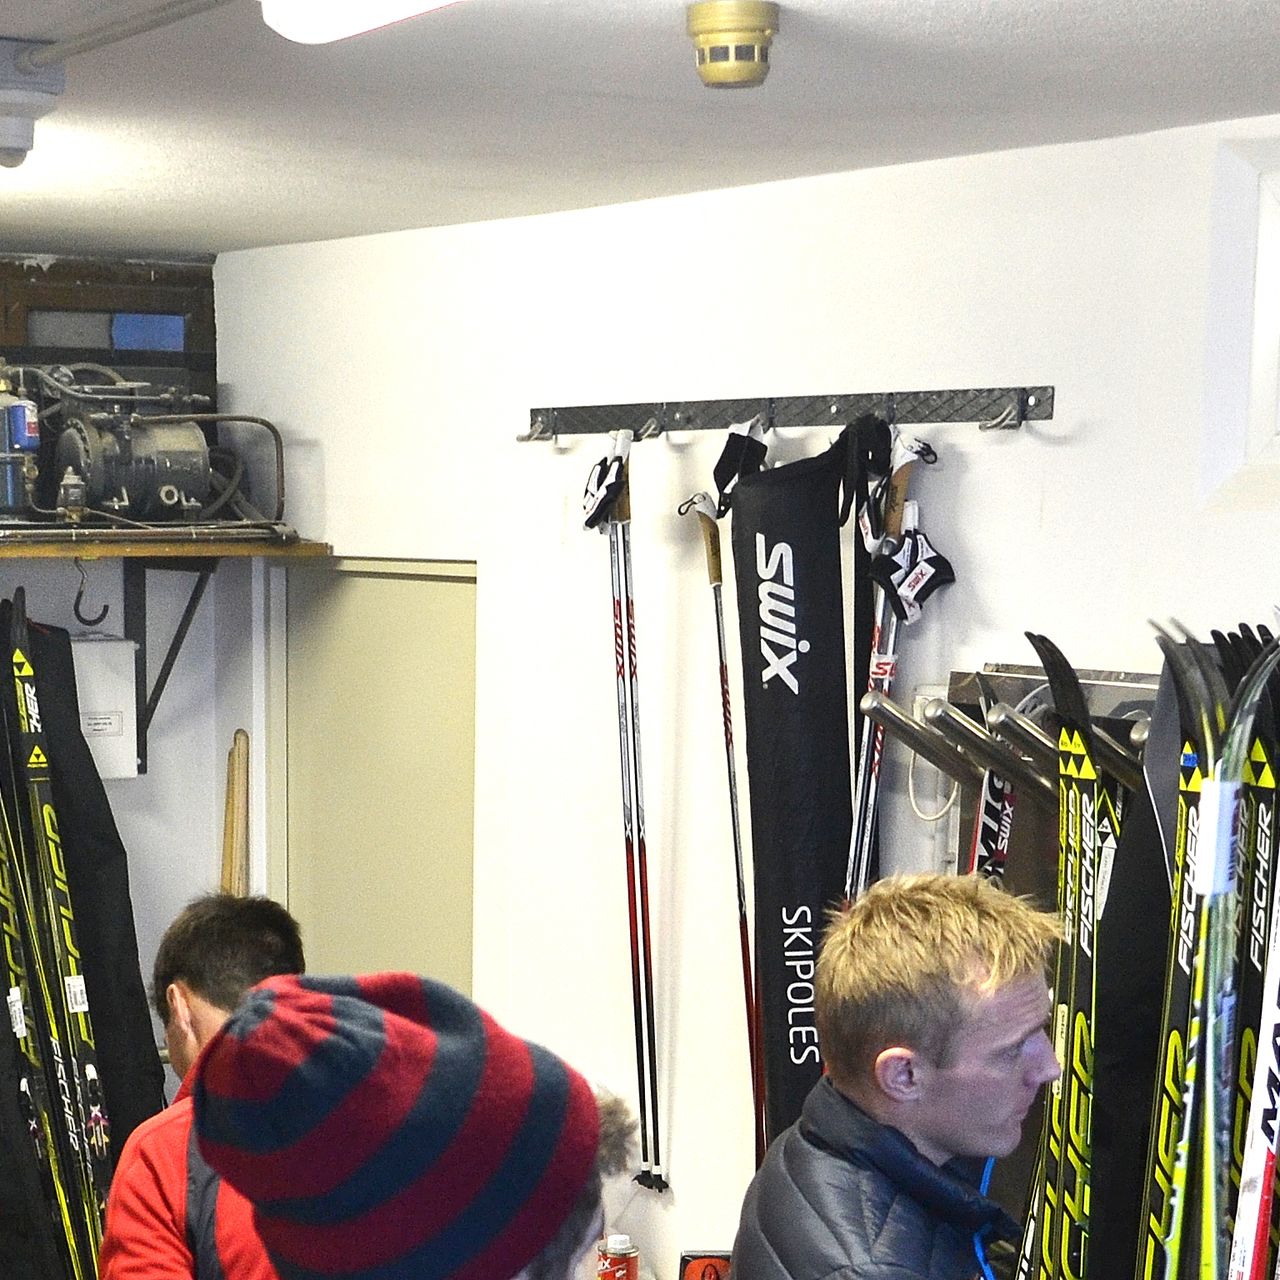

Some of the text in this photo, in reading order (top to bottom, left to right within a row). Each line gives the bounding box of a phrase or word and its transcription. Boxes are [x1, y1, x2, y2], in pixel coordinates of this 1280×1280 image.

[1079, 792, 1096, 959] FISCHER
[1176, 804, 1201, 977] FISCHER
[1248, 800, 1274, 974] FISCHER
[50, 1038, 80, 1152] FISCHER
